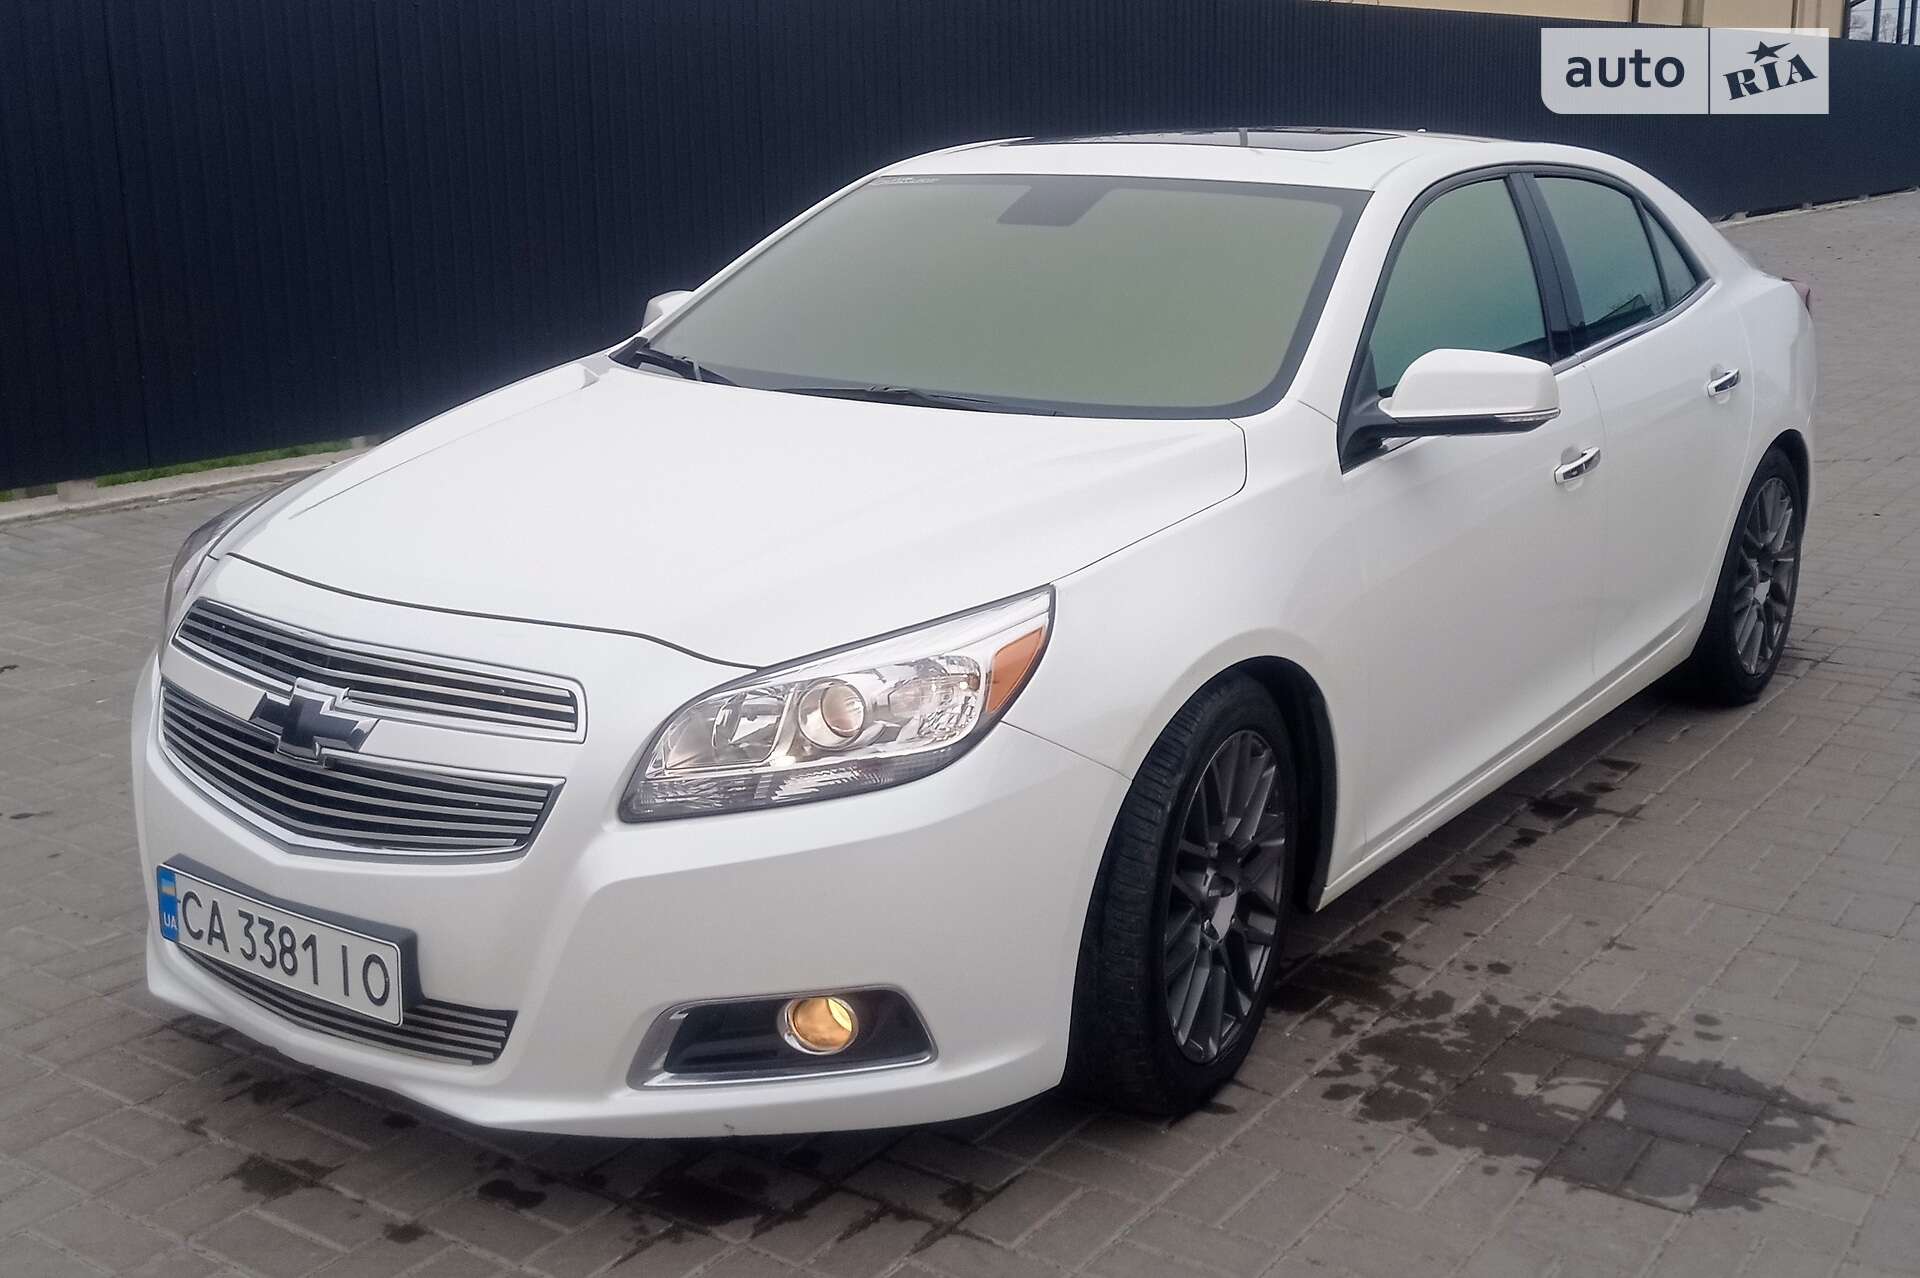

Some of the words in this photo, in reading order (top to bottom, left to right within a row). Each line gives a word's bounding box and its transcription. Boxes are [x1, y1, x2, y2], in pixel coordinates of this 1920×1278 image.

[163, 911, 178, 930] UA
[182, 891, 229, 953] CA
[238, 909, 319, 985] 3381
[341, 945, 390, 1006] IO
